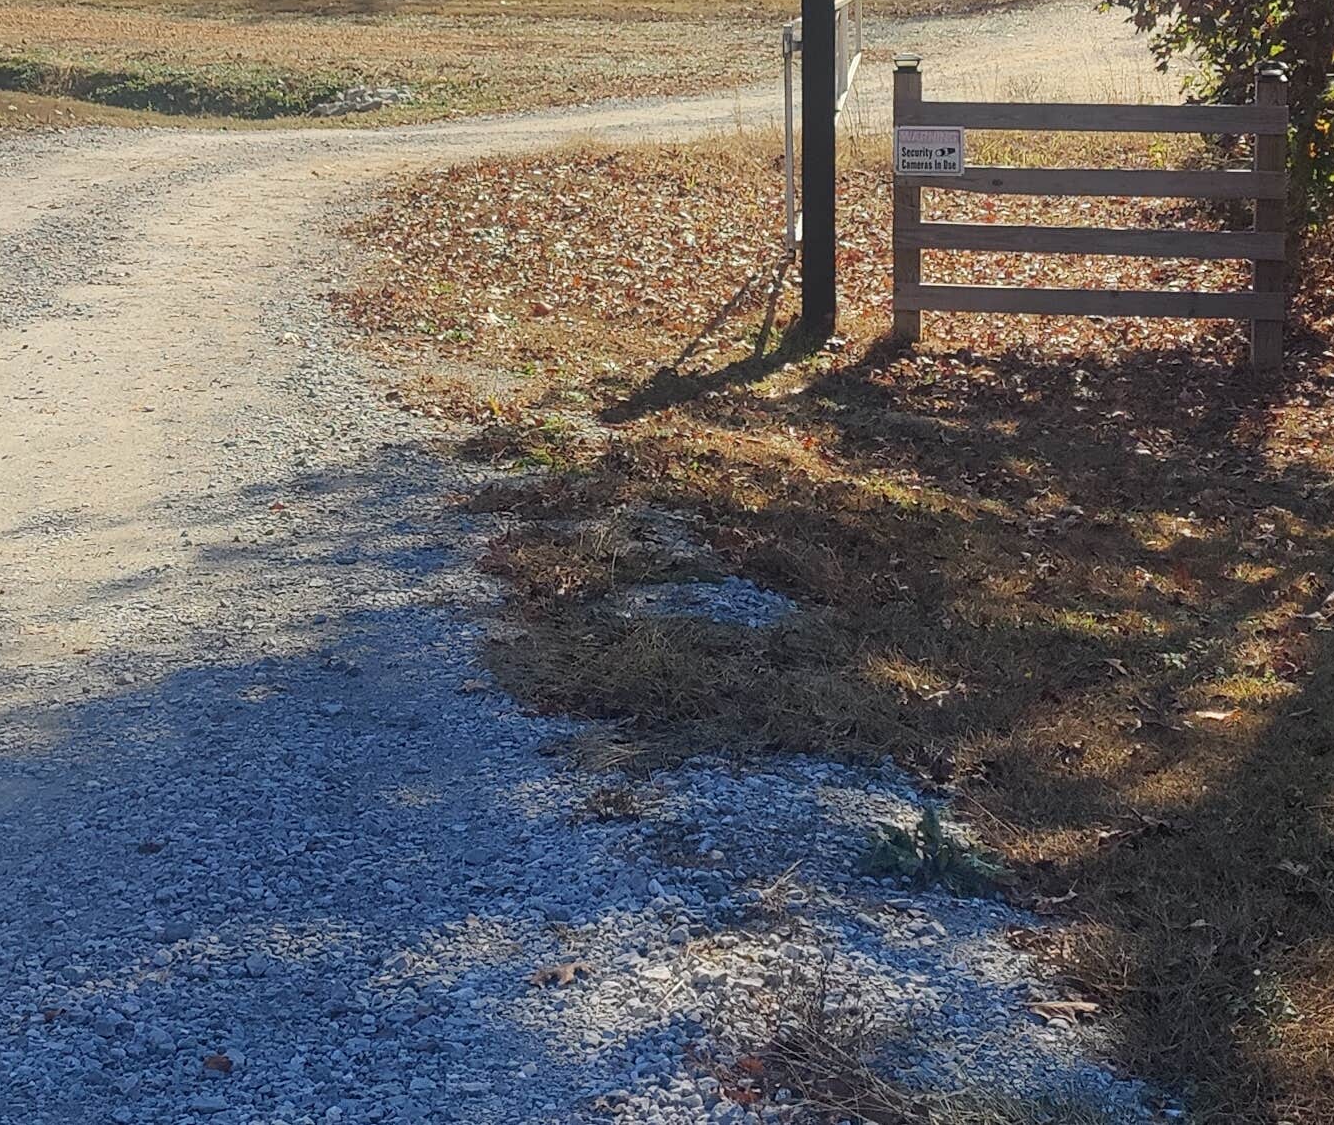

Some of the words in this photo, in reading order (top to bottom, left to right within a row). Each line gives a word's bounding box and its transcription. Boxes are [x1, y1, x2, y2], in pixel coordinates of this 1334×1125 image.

[902, 147, 933, 159] Security
[902, 159, 933, 169] Cameras
[935, 159, 942, 169] In
[943, 159, 957, 169] Use
